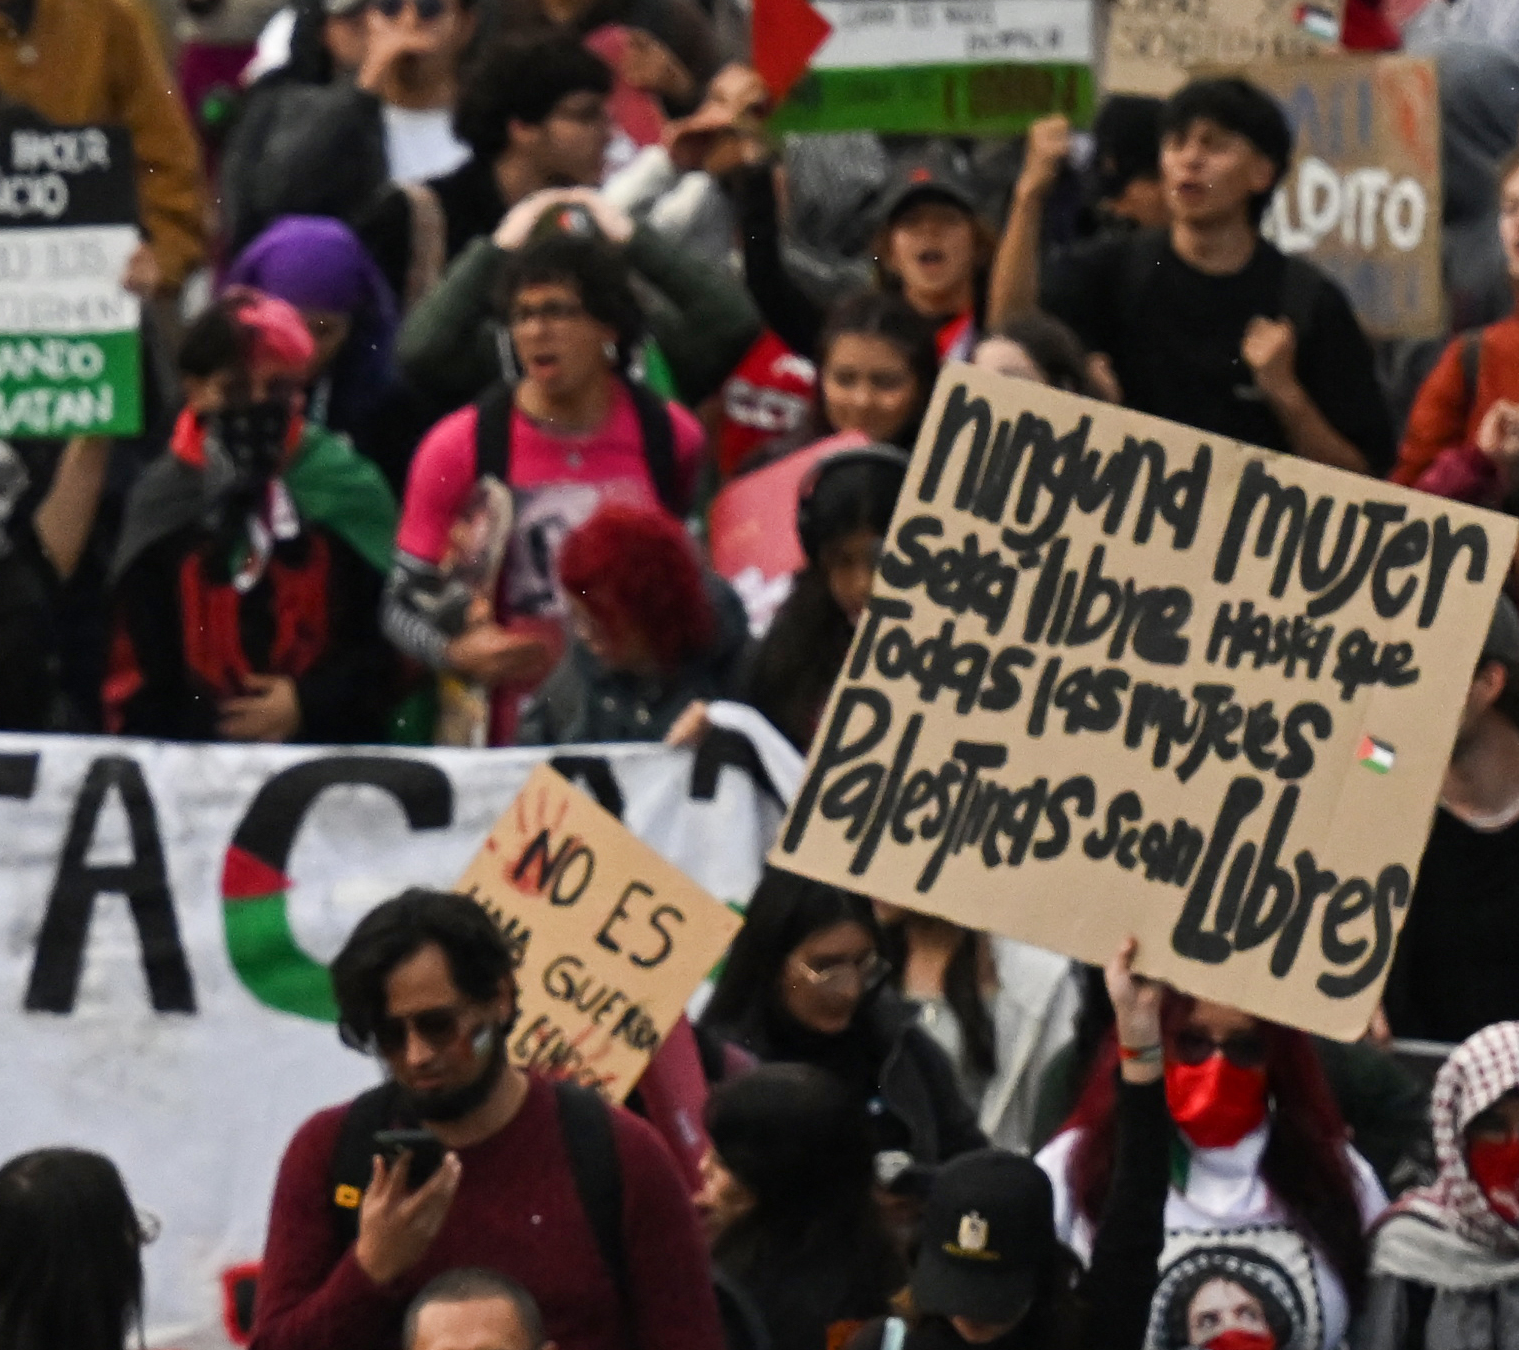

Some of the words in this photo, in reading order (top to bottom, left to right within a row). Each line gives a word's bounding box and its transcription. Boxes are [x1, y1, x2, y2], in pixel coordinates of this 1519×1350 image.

[1262, 155, 1427, 257] LDITO
[509, 826, 596, 909] NO
[592, 878, 688, 971] ES
